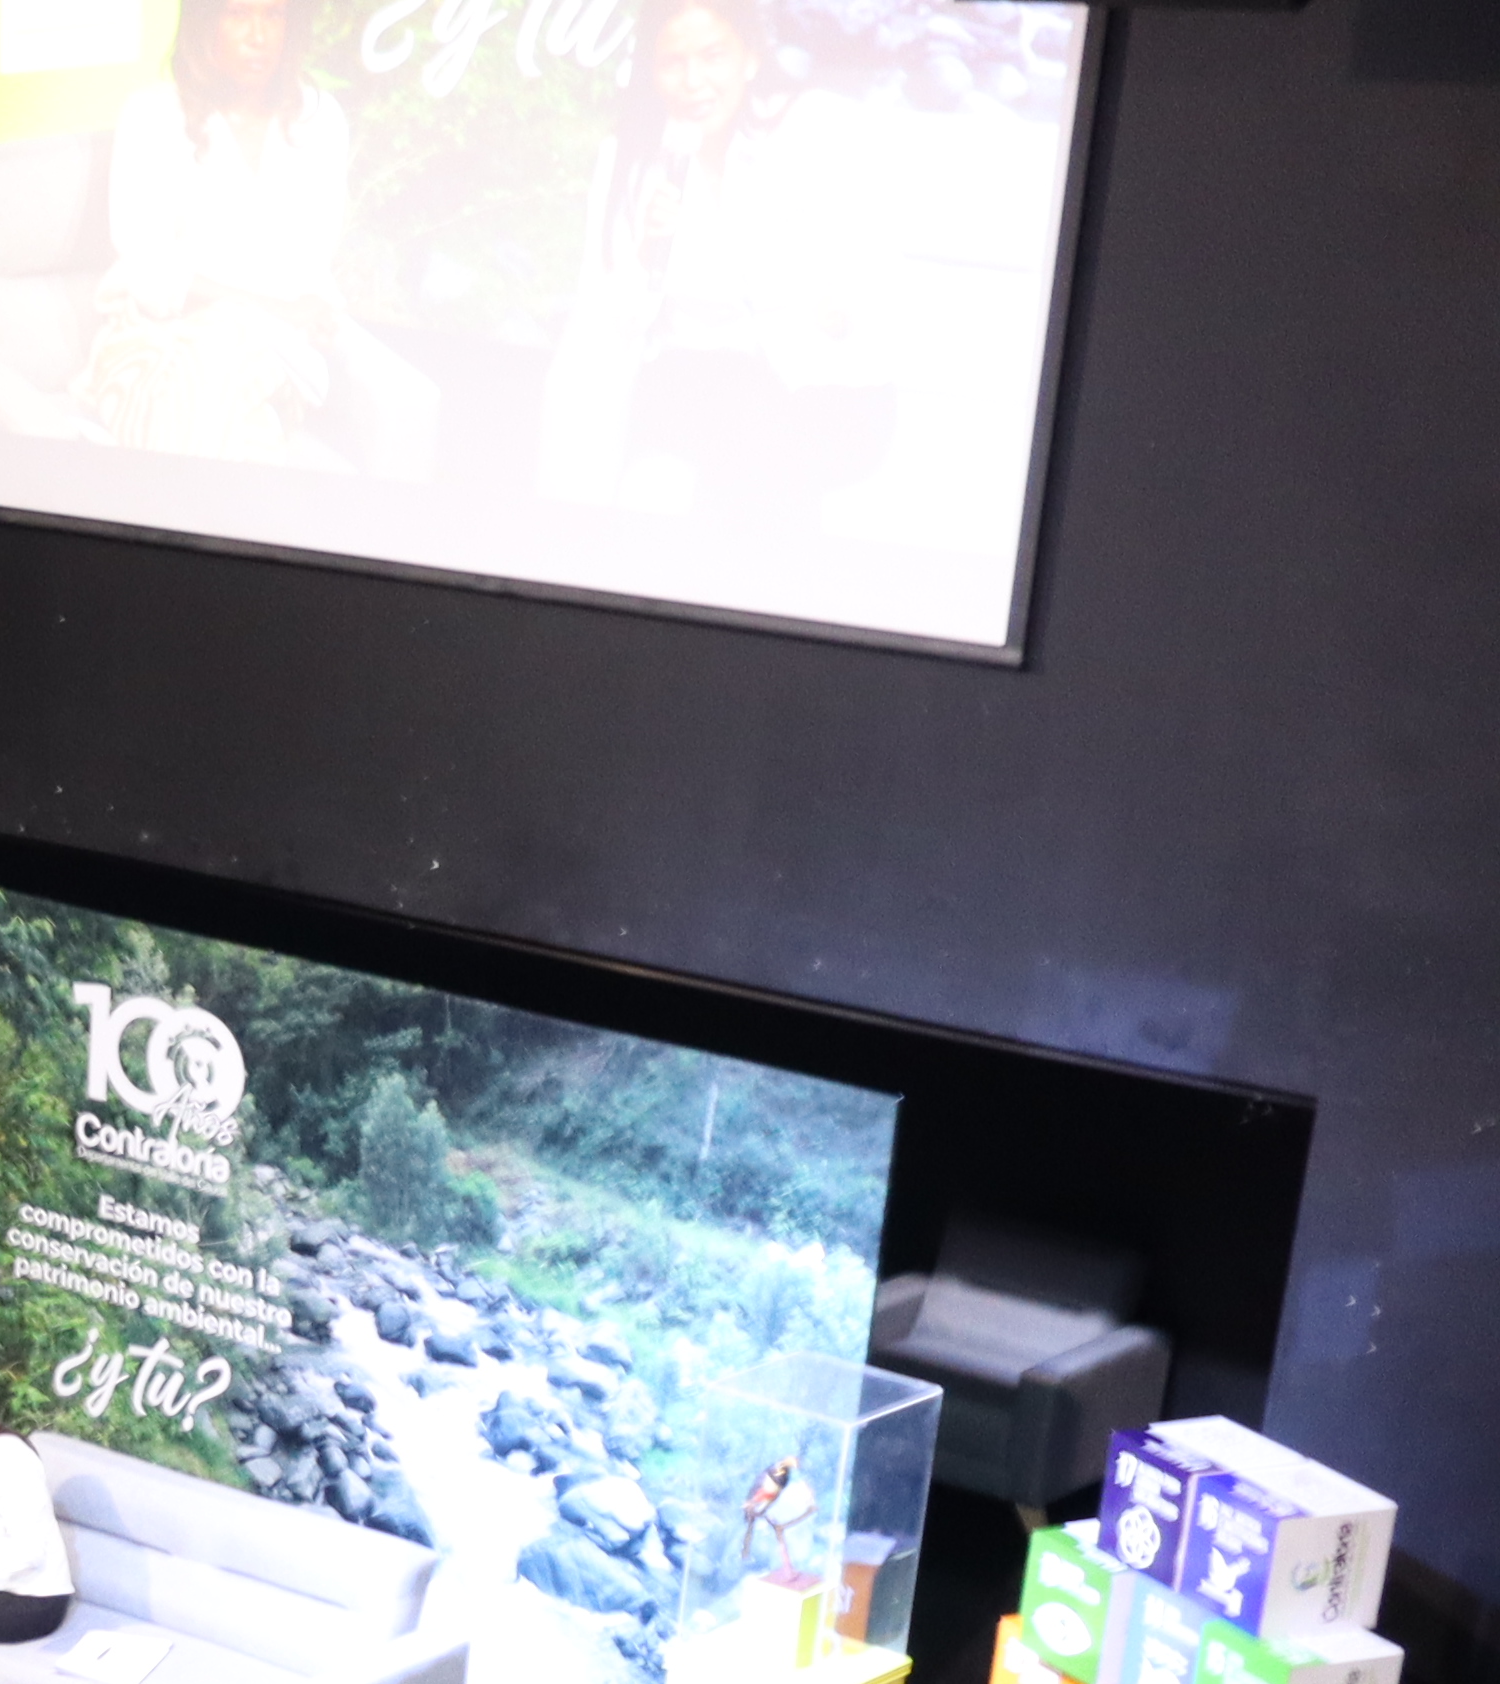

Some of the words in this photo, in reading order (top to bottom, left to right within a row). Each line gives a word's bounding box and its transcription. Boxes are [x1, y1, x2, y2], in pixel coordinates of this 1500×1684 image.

[74, 1112, 230, 1184] Contraloría
[19, 1204, 204, 1274] comprometidos
[208, 1258, 254, 1290] con
[256, 1268, 282, 1297] la
[98, 1193, 201, 1244] Estamos
[6, 1228, 158, 1288] conservación
[162, 1271, 195, 1298] de
[198, 1284, 293, 1328] nuestro
[13, 1255, 141, 1310] patrimonio
[143, 1297, 283, 1353] ambiental...
[53, 1328, 130, 1418] ¿y
